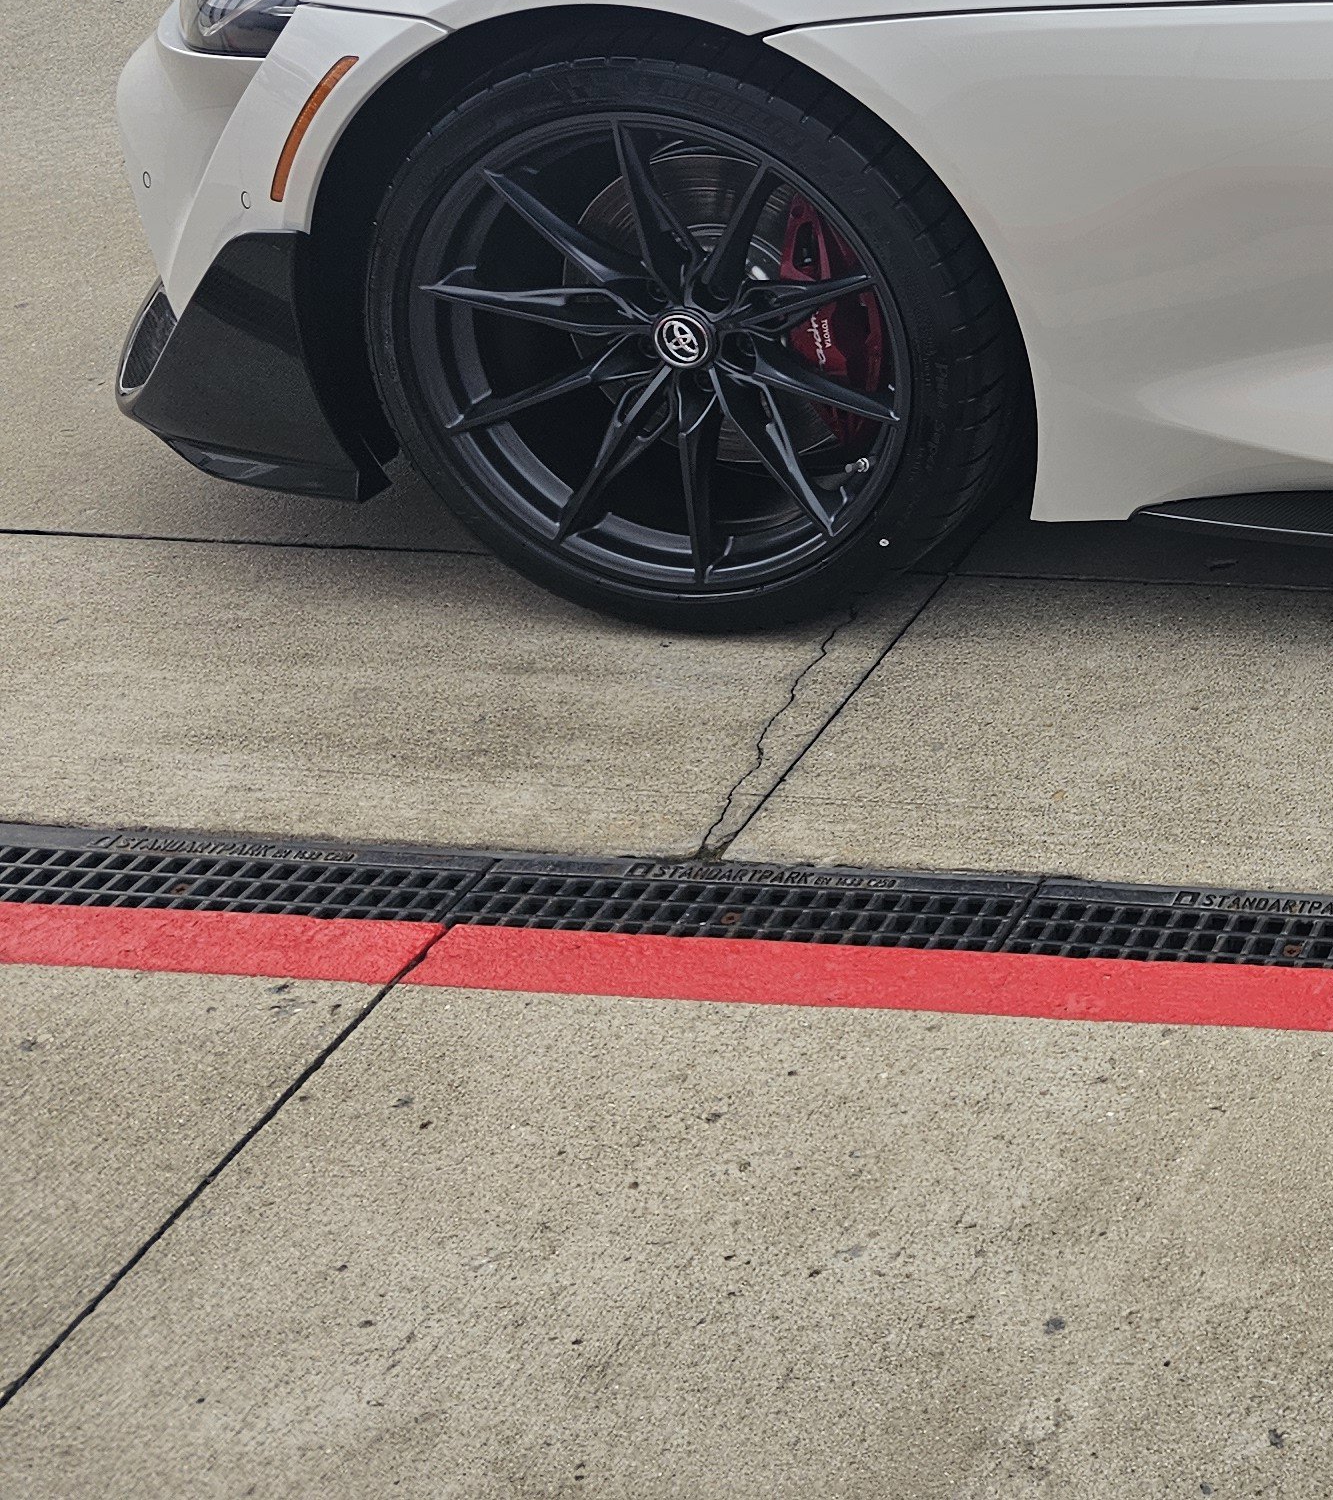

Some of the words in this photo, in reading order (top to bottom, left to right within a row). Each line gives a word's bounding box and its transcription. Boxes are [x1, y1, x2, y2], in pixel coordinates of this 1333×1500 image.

[806, 311, 826, 366] upra
[821, 319, 832, 348] TOYOTA
[653, 864, 816, 886] STANDARTPARK
